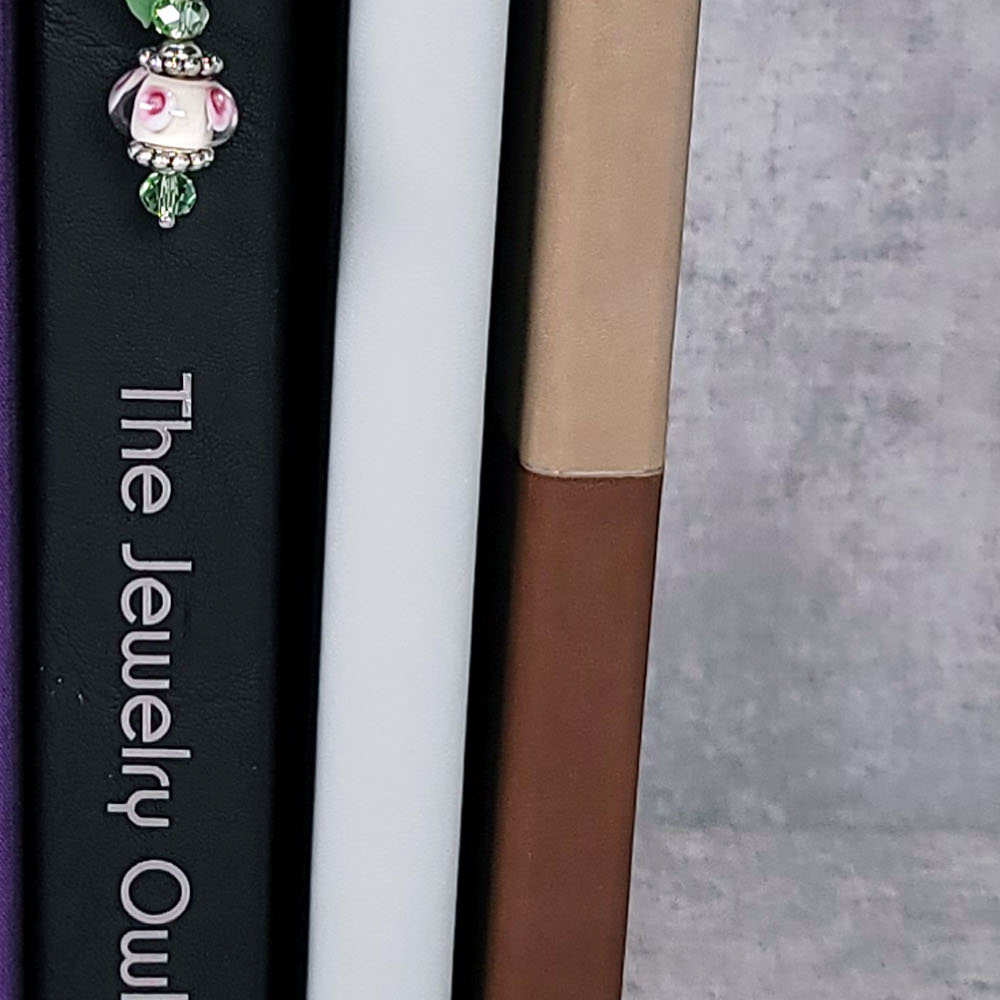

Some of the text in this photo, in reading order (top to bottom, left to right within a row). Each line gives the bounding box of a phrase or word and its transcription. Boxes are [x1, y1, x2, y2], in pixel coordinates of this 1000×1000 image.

[106, 371, 193, 1000] The Jewelry Owl
